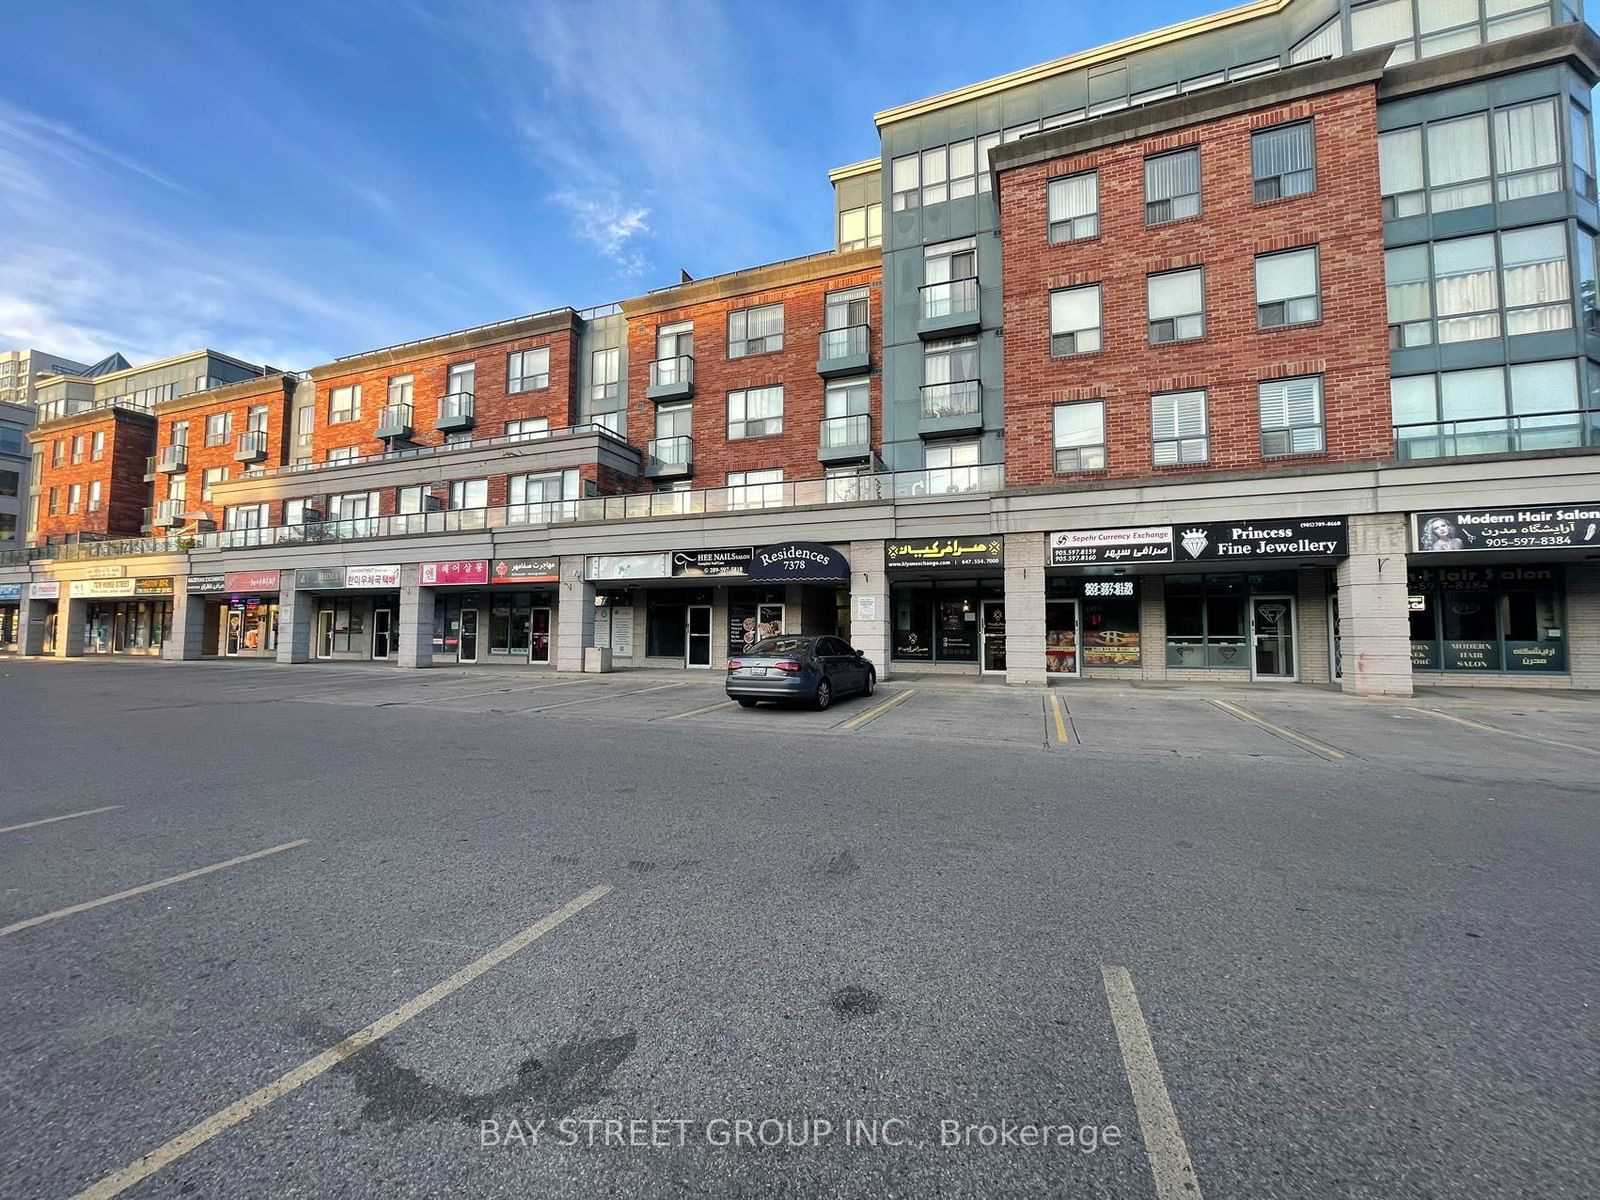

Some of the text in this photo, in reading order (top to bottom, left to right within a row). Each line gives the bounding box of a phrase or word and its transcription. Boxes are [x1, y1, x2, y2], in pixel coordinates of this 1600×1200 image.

[1457, 509, 1600, 525] Modern Hair Salon
[1231, 526, 1293, 540] Princess
[1481, 522, 1575, 537] آرایشگاه مدرن
[1072, 531, 1169, 543] Sepehr Currency Exchange
[1485, 536, 1572, 547] 905-597-8384
[1104, 545, 1168, 560] صرافی سپهر
[1217, 539, 1338, 555] Fine Jewellery
[713, 552, 736, 561] NAILS
[760, 545, 830, 567] Residences
[783, 560, 806, 570] 7378
